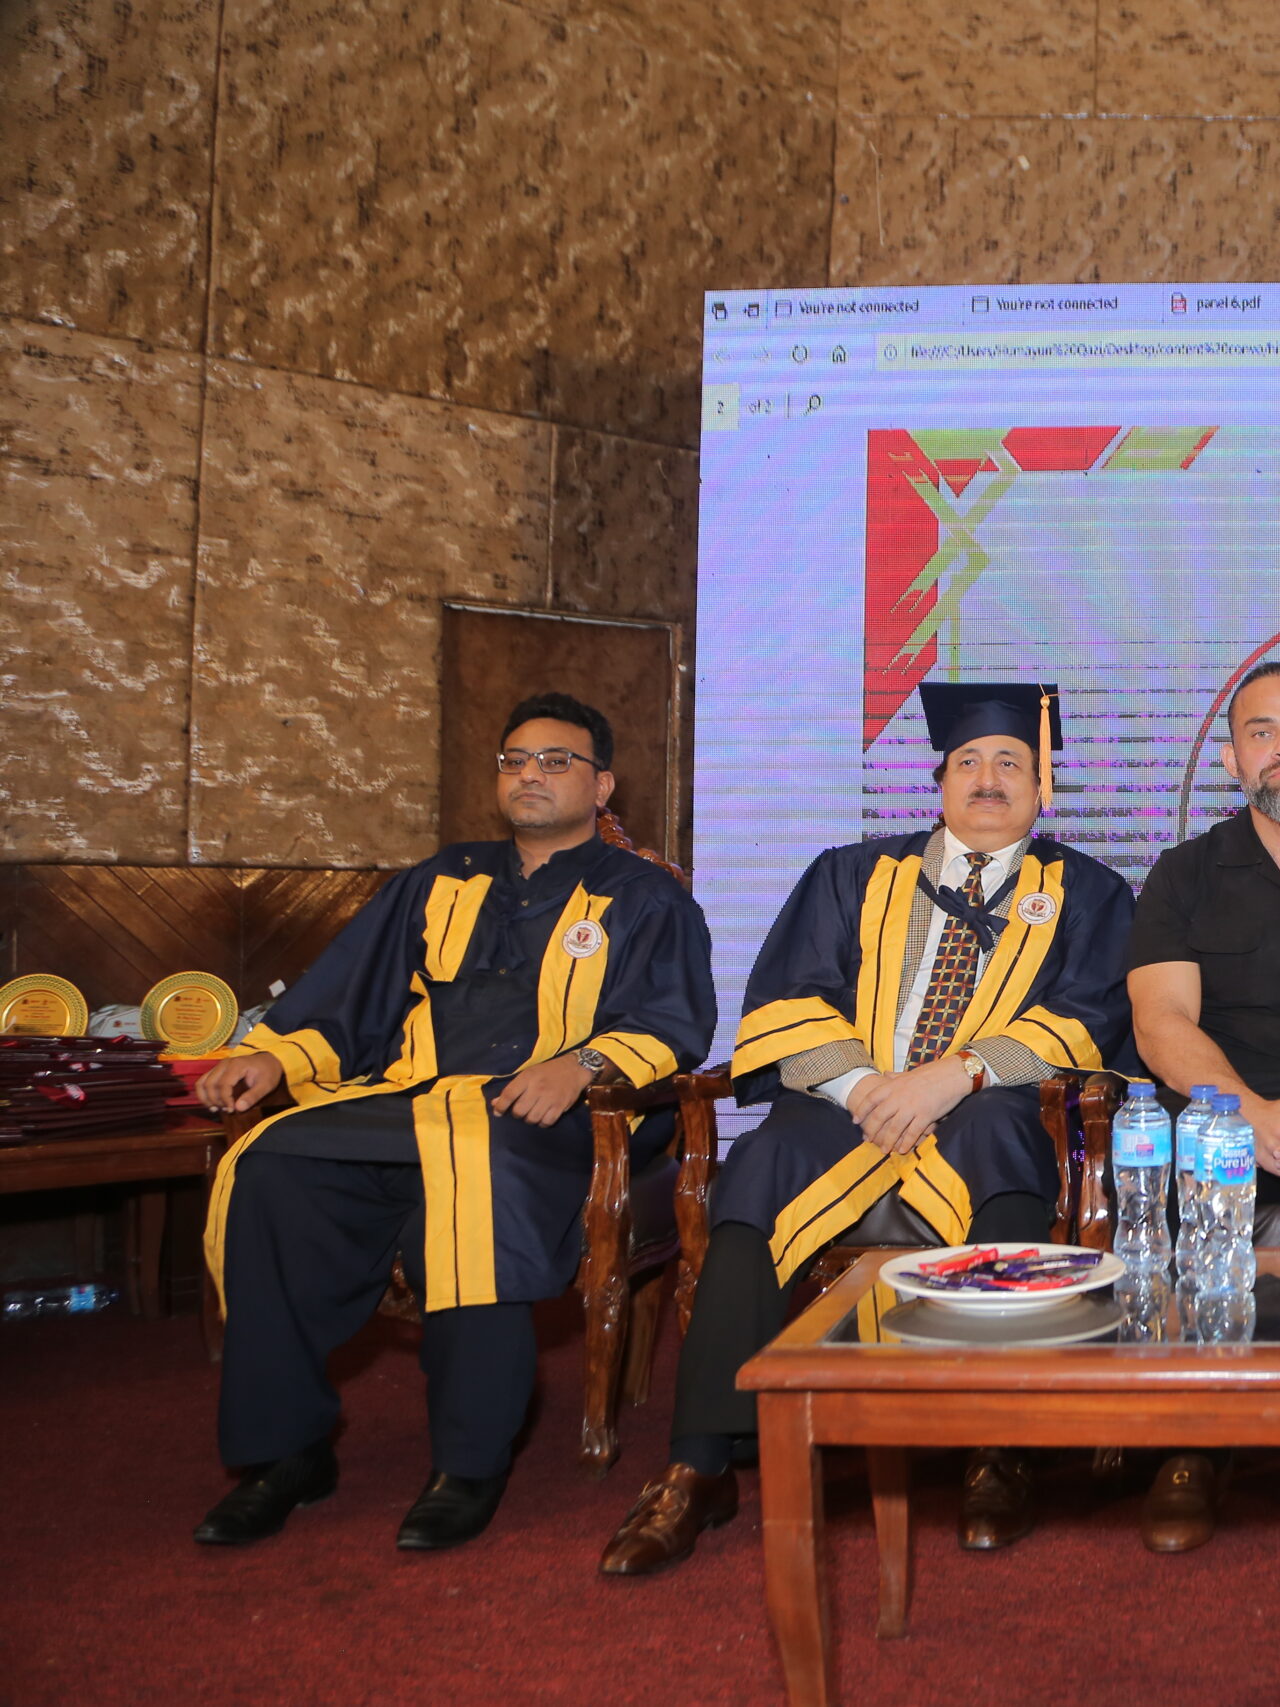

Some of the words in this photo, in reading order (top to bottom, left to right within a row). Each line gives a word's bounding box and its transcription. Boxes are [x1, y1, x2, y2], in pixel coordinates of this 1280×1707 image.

[799, 300, 834, 315] You're
[837, 301, 856, 314] not
[859, 299, 919, 314] connected
[996, 297, 1032, 311] You're
[1034, 298, 1055, 311] not
[1057, 296, 1118, 310] connected
[1197, 296, 1228, 312] panel
[1213, 1157, 1240, 1169] Pure
